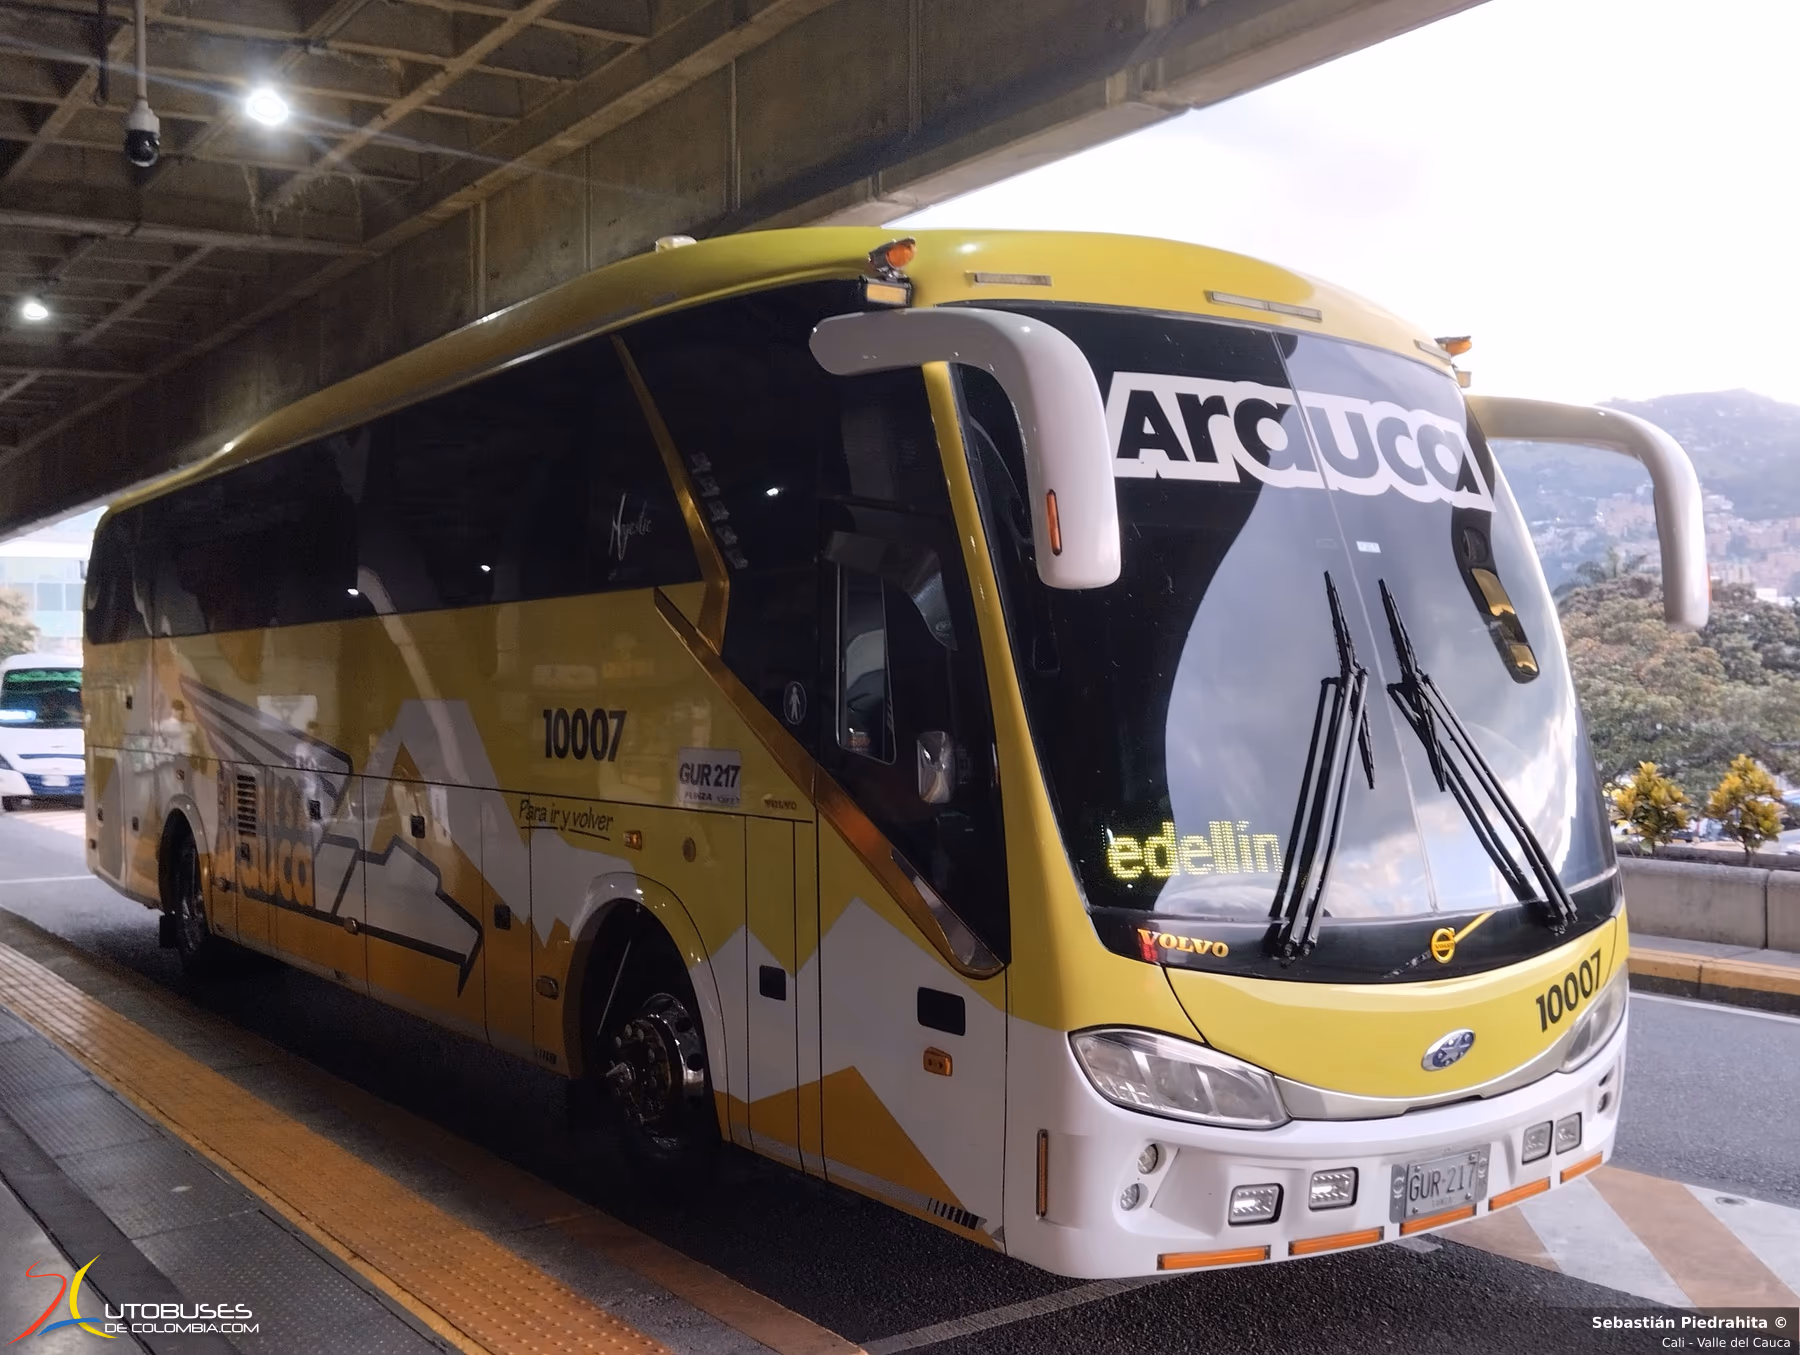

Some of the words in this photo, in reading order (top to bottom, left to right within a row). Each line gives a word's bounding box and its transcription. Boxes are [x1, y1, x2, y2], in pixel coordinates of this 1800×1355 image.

[1112, 384, 1487, 500] Arauca
[542, 707, 627, 762] 10007
[679, 762, 712, 786] GUR
[713, 764, 741, 788] 217
[519, 799, 547, 823] Para
[550, 803, 560, 823] ir
[560, 811, 571, 831] y
[572, 806, 614, 831] volver
[1137, 928, 1229, 957] VOLVO
[1536, 950, 1602, 1032] 10007
